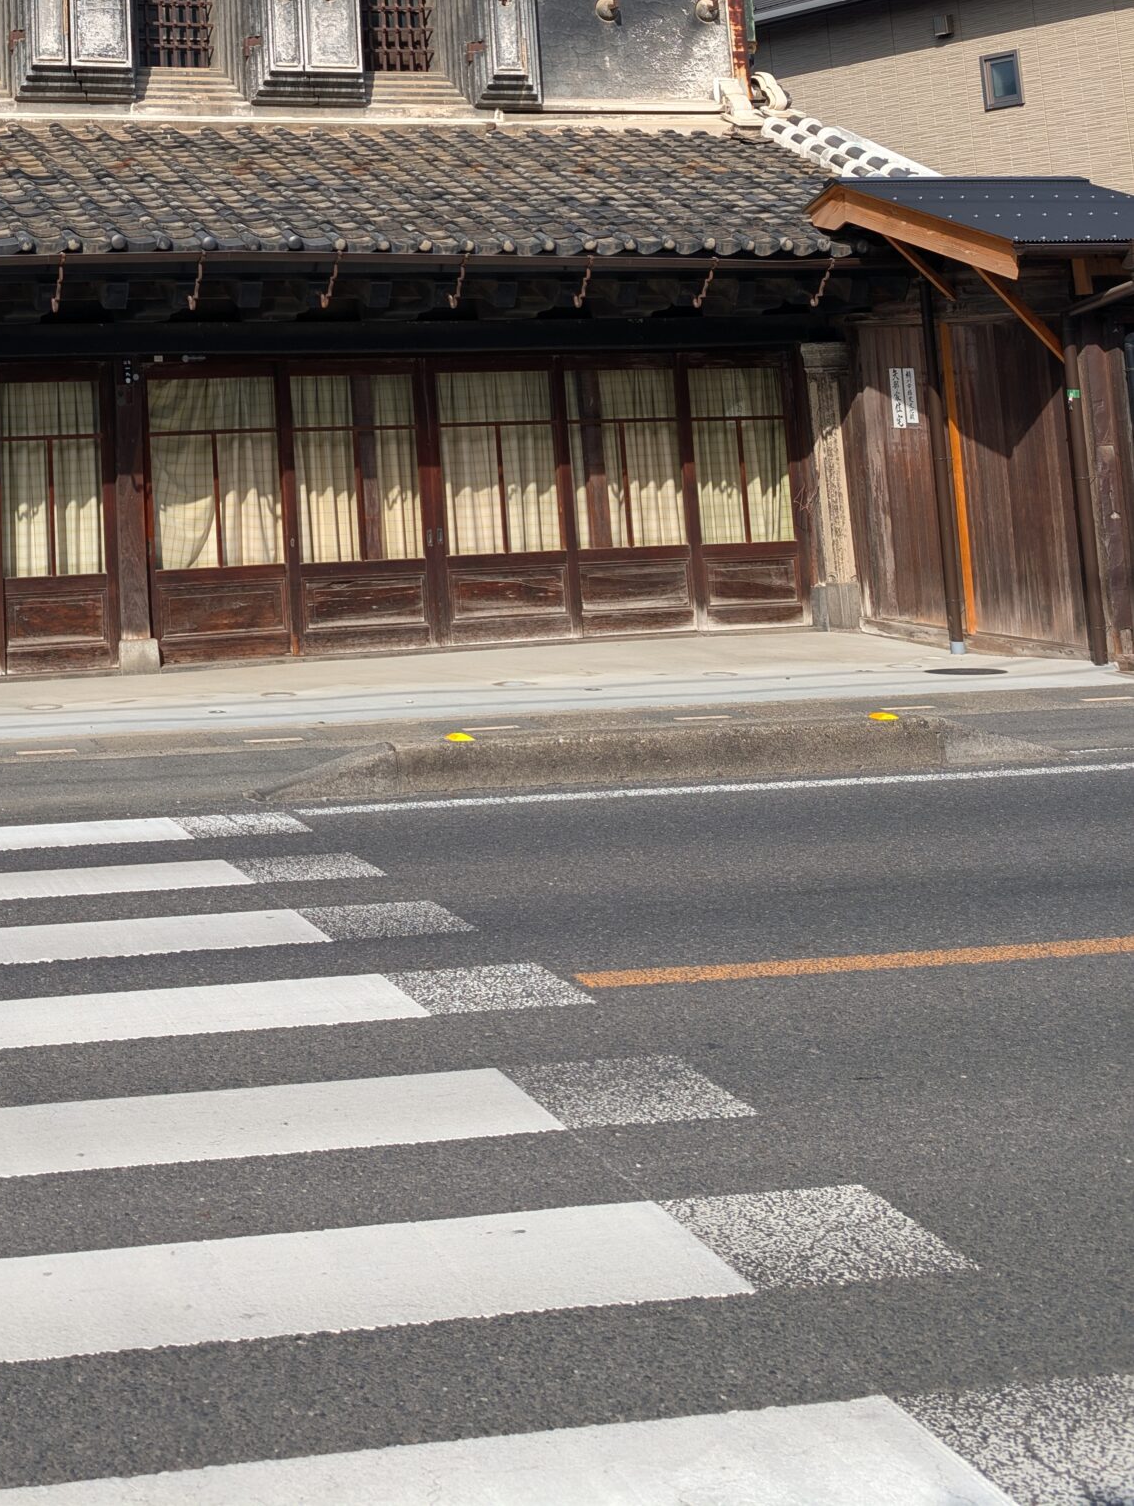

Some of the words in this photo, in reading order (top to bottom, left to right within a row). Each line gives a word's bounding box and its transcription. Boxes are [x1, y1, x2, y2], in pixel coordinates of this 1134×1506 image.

[892, 369, 904, 427] 矢部家住宅
